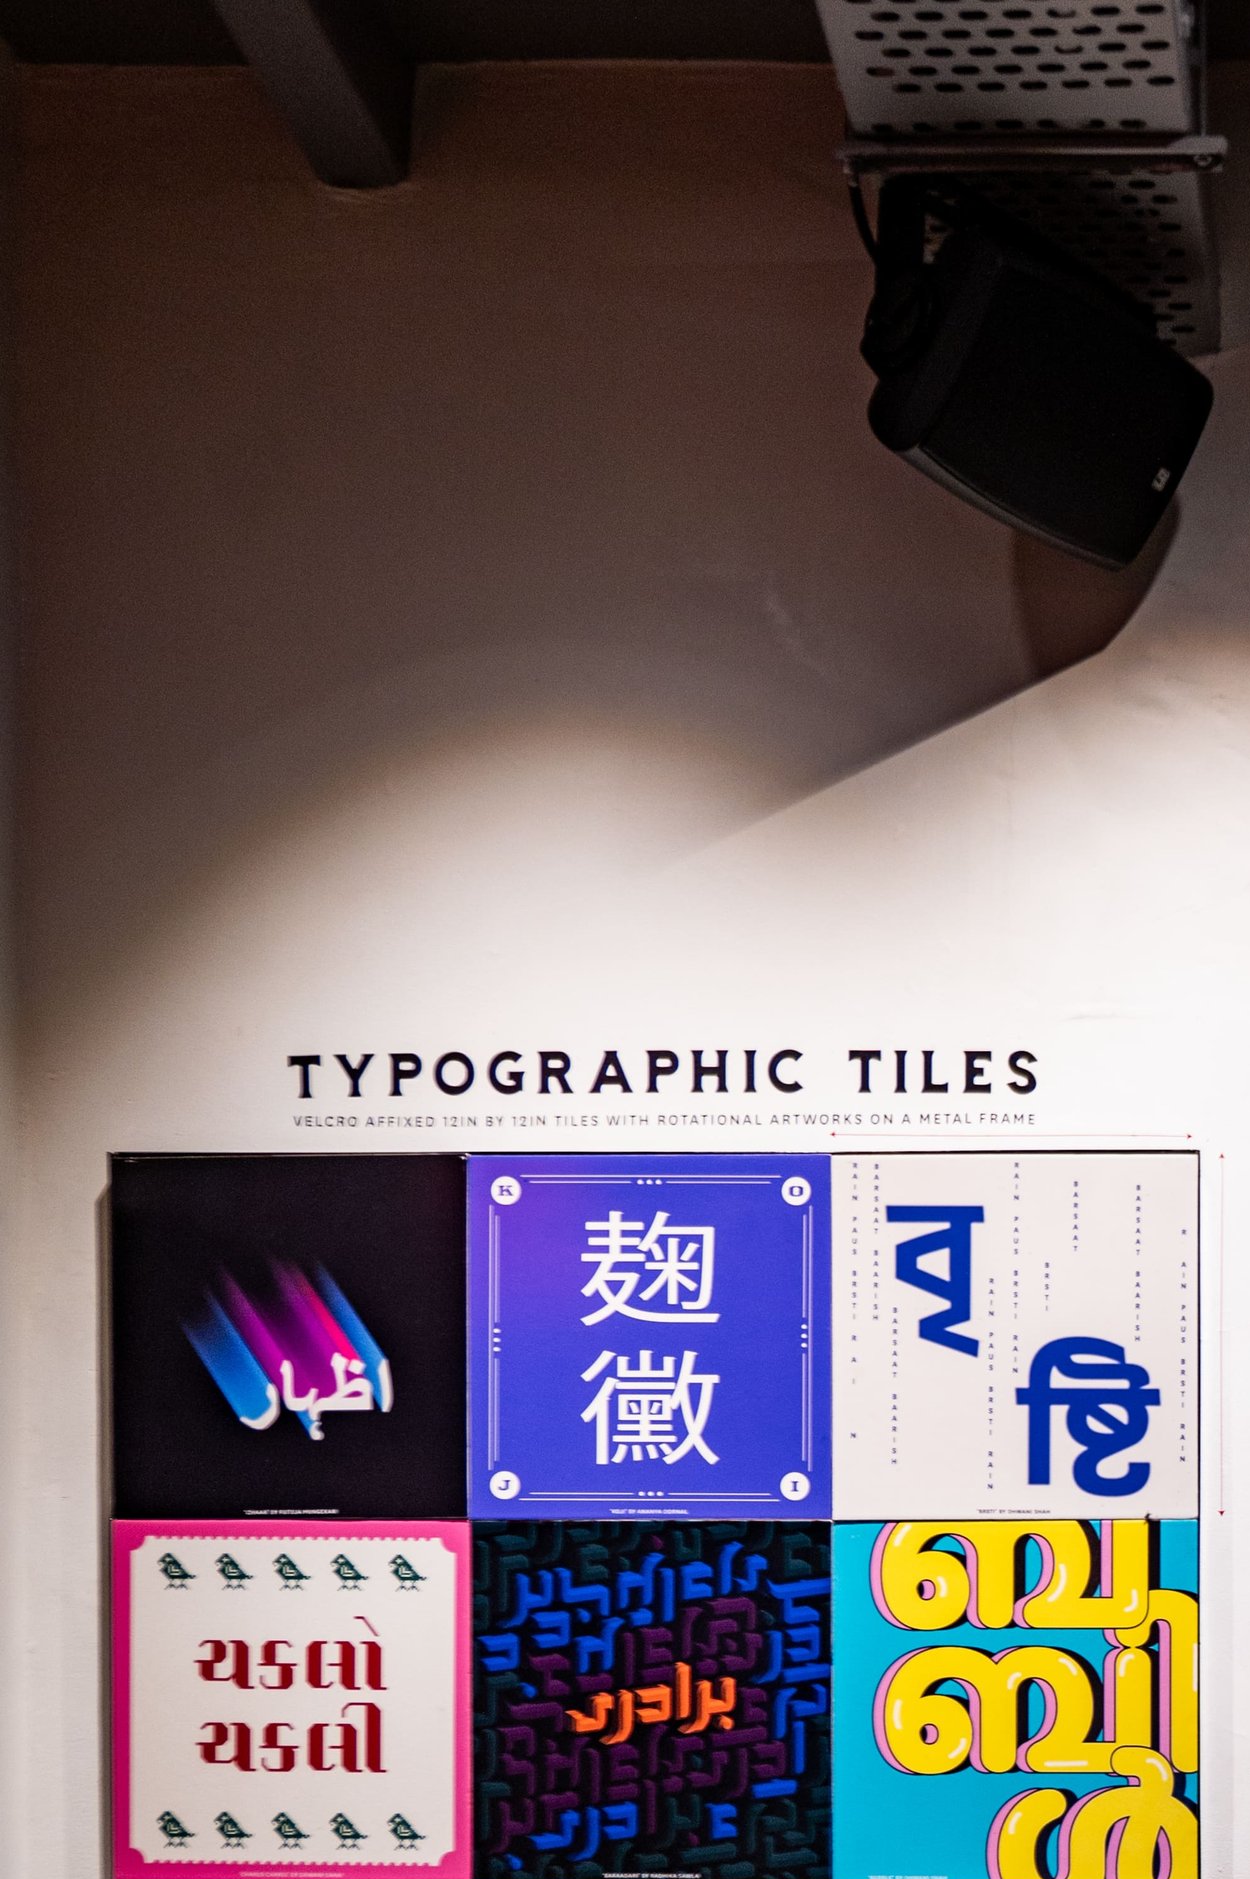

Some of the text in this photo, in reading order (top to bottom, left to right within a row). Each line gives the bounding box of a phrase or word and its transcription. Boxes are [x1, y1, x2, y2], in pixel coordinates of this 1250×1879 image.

[287, 1049, 1038, 1099] TYPOGRAPHIC TILES
[293, 1113, 1036, 1128] VELCRO AFFIXED 12IN BY 12IN TILES WITH ROTATIONAL ARTWORKS ON A METAL FRAME
[497, 1184, 513, 1197] K
[788, 1185, 804, 1197] O
[497, 1480, 511, 1492] J
[790, 1480, 800, 1493] I
[194, 1616, 388, 1690] ચકલો
[195, 1702, 388, 1773] ચકલી
